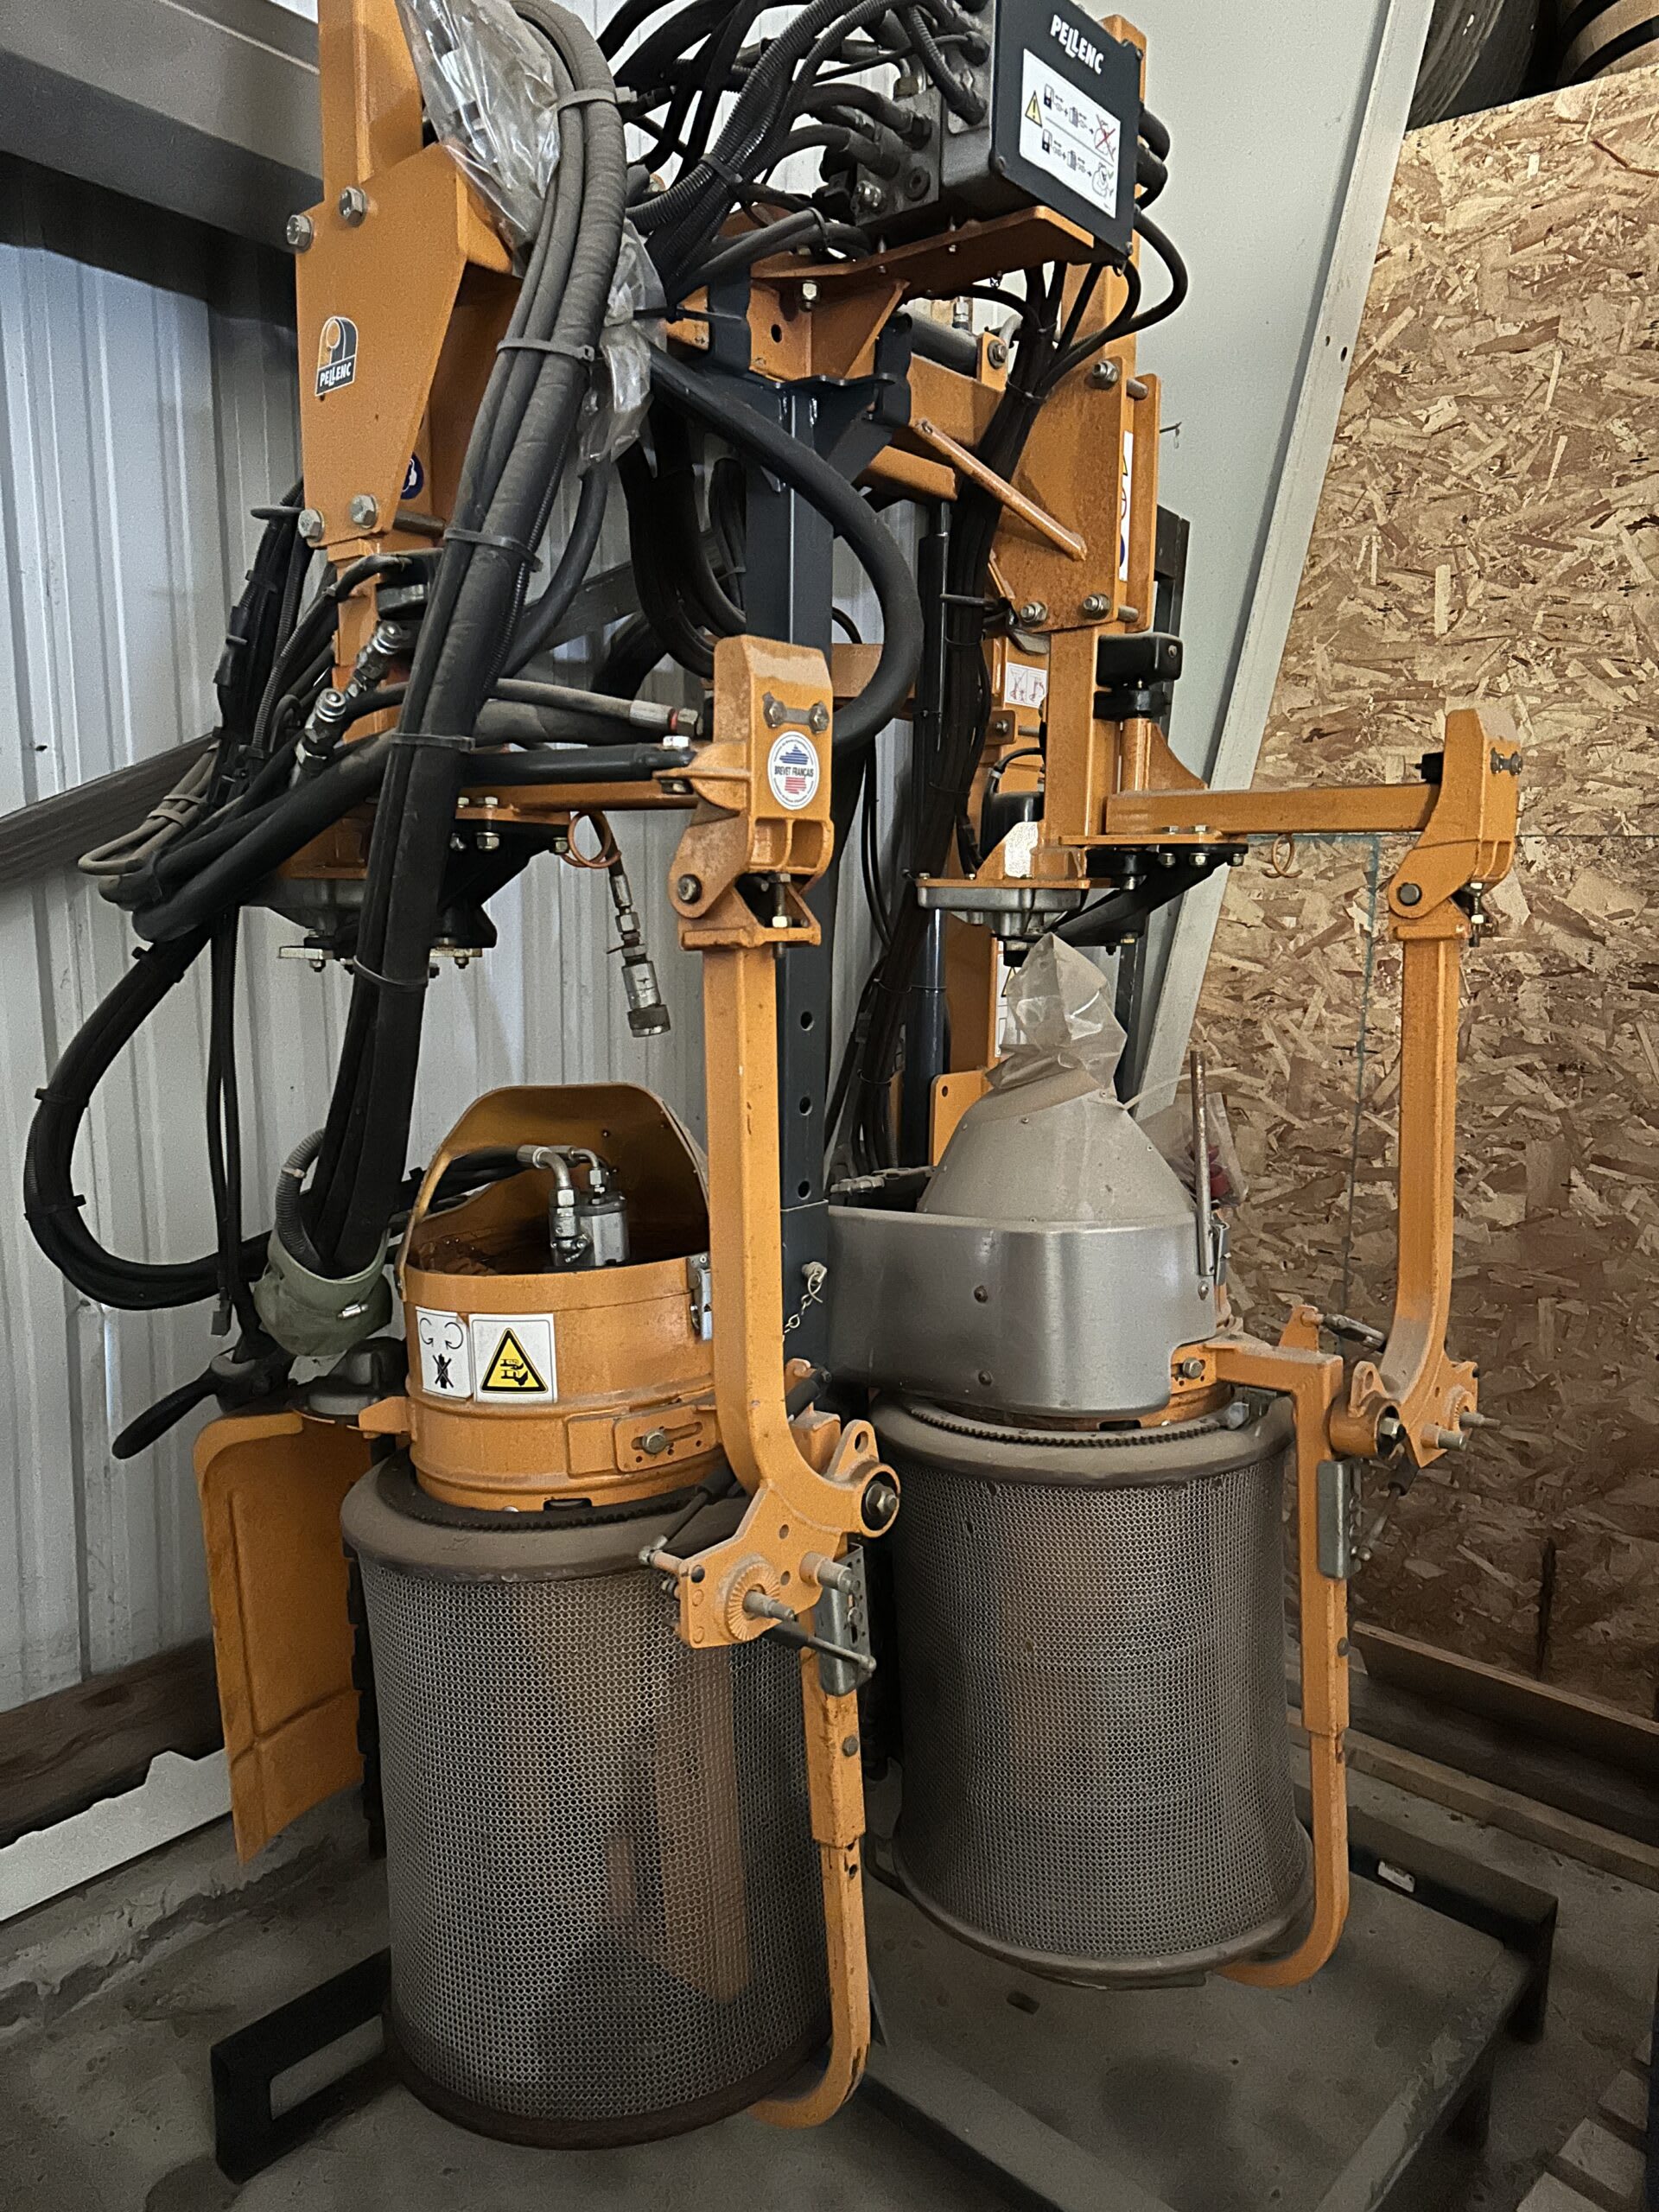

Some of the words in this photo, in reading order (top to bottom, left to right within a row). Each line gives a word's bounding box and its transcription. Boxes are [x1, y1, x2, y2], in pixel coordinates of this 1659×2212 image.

[1050, 15, 1104, 74] PELLENC
[319, 362, 352, 387] PELLENC
[774, 766, 791, 775] BREVET
